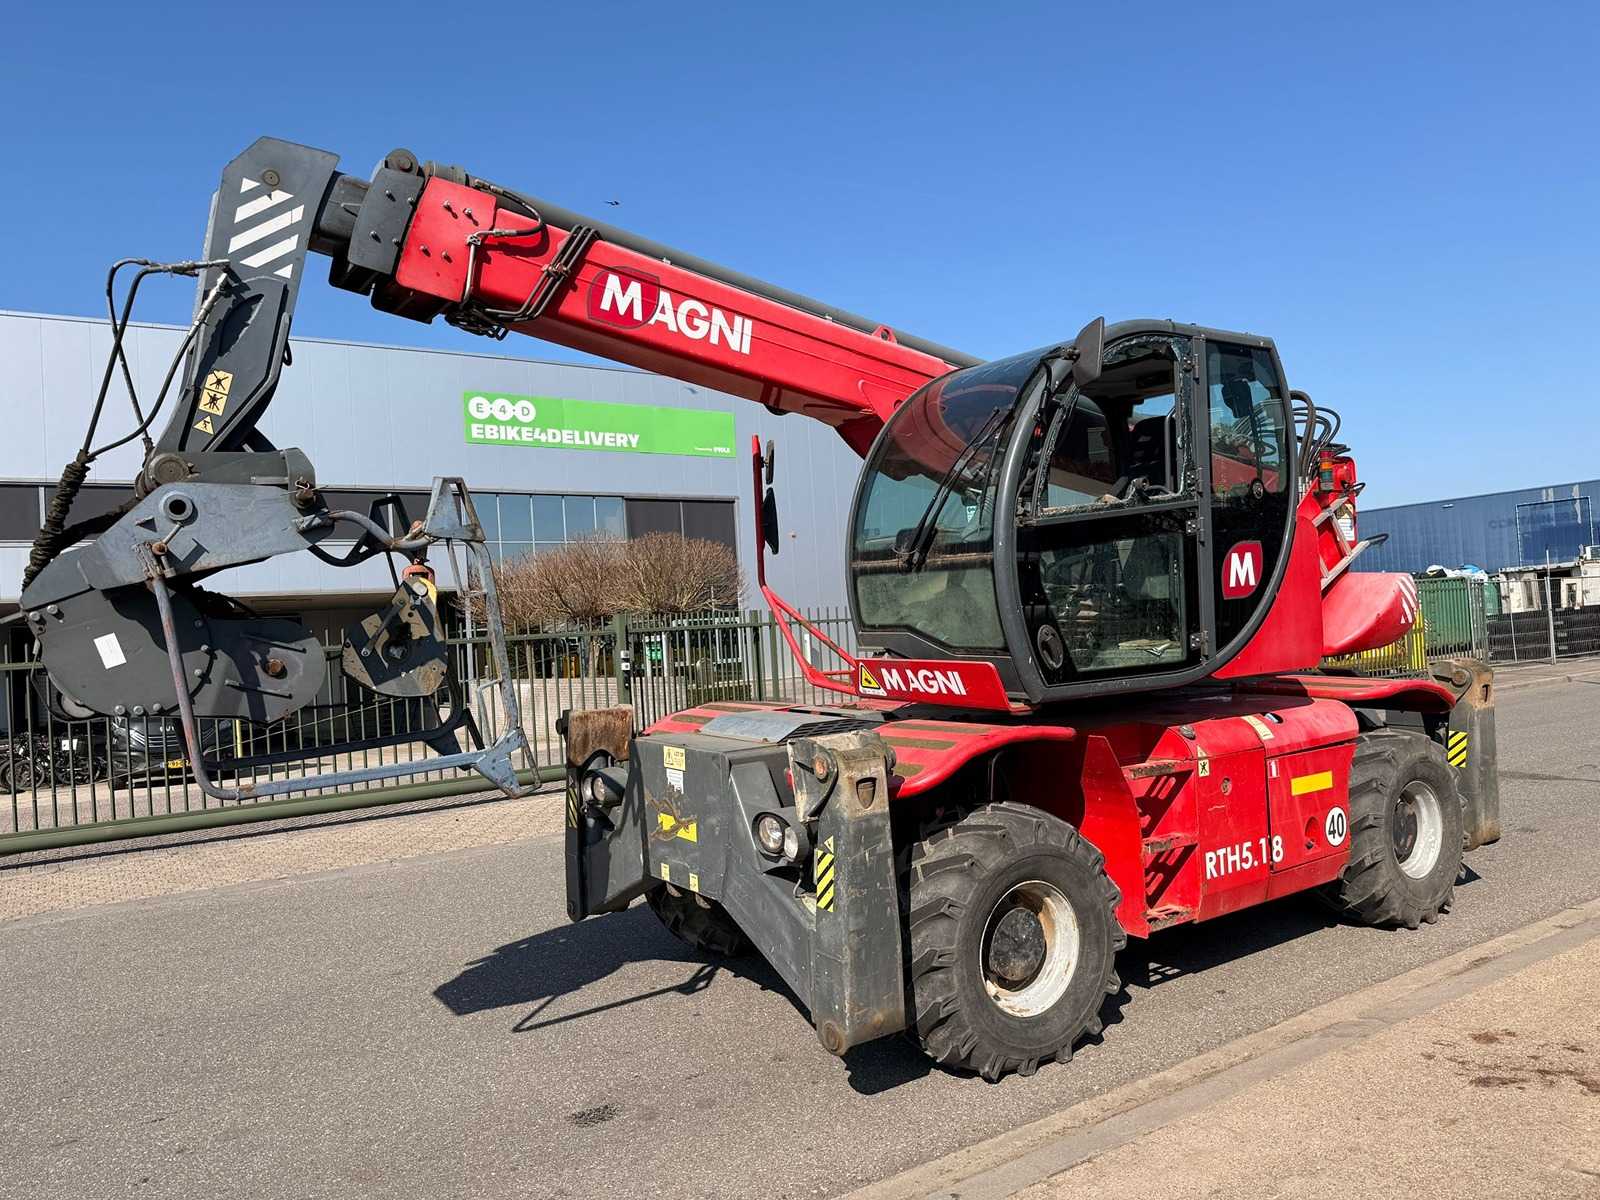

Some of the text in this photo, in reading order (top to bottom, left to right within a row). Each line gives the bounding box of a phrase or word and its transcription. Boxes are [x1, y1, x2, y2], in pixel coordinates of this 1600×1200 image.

[600, 273, 753, 355] MAGNI
[470, 423, 640, 448] EBIKE4DELIVERY
[1229, 551, 1257, 588] M
[880, 667, 967, 696] MAGNI
[1327, 812, 1346, 840] 40
[1204, 834, 1285, 881] RTH5.18
